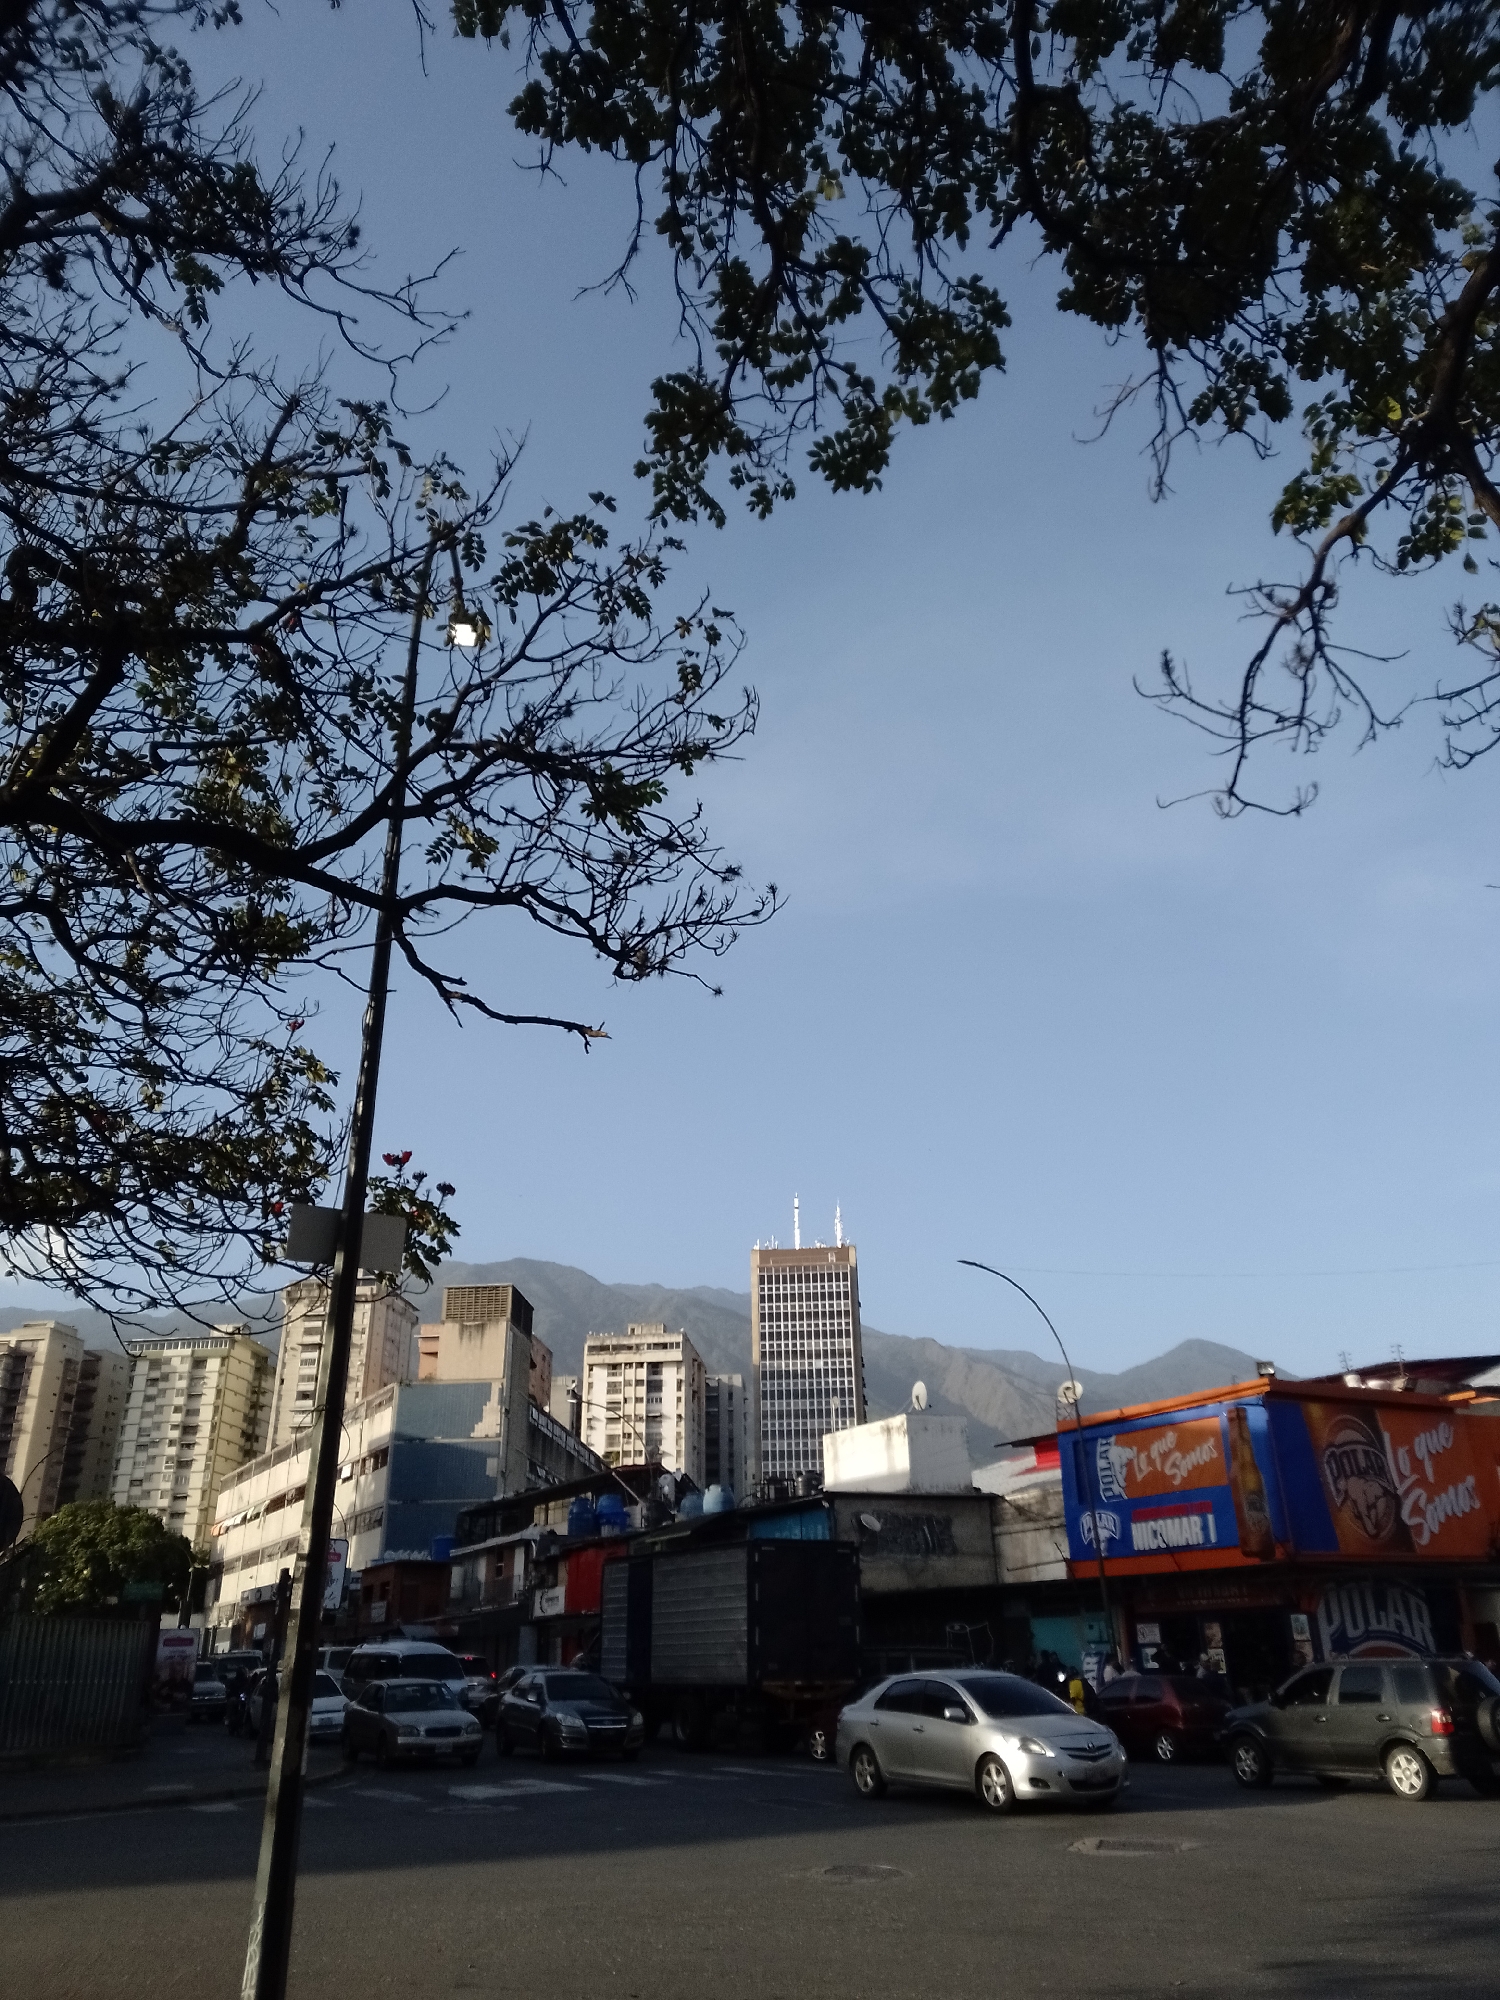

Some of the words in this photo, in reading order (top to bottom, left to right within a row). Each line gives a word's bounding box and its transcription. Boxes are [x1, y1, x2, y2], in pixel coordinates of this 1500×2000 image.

[1133, 1446, 1152, 1482] Lo
[1151, 1431, 1177, 1471] que
[1164, 1437, 1218, 1486] Somos
[1325, 1448, 1391, 1495] POLAR
[1383, 1430, 1420, 1496] Lo
[1414, 1422, 1453, 1483] que
[1131, 1514, 1204, 1551] NICOMAR
[1401, 1475, 1480, 1546] Somos
[1317, 1581, 1437, 1662] POLAR
